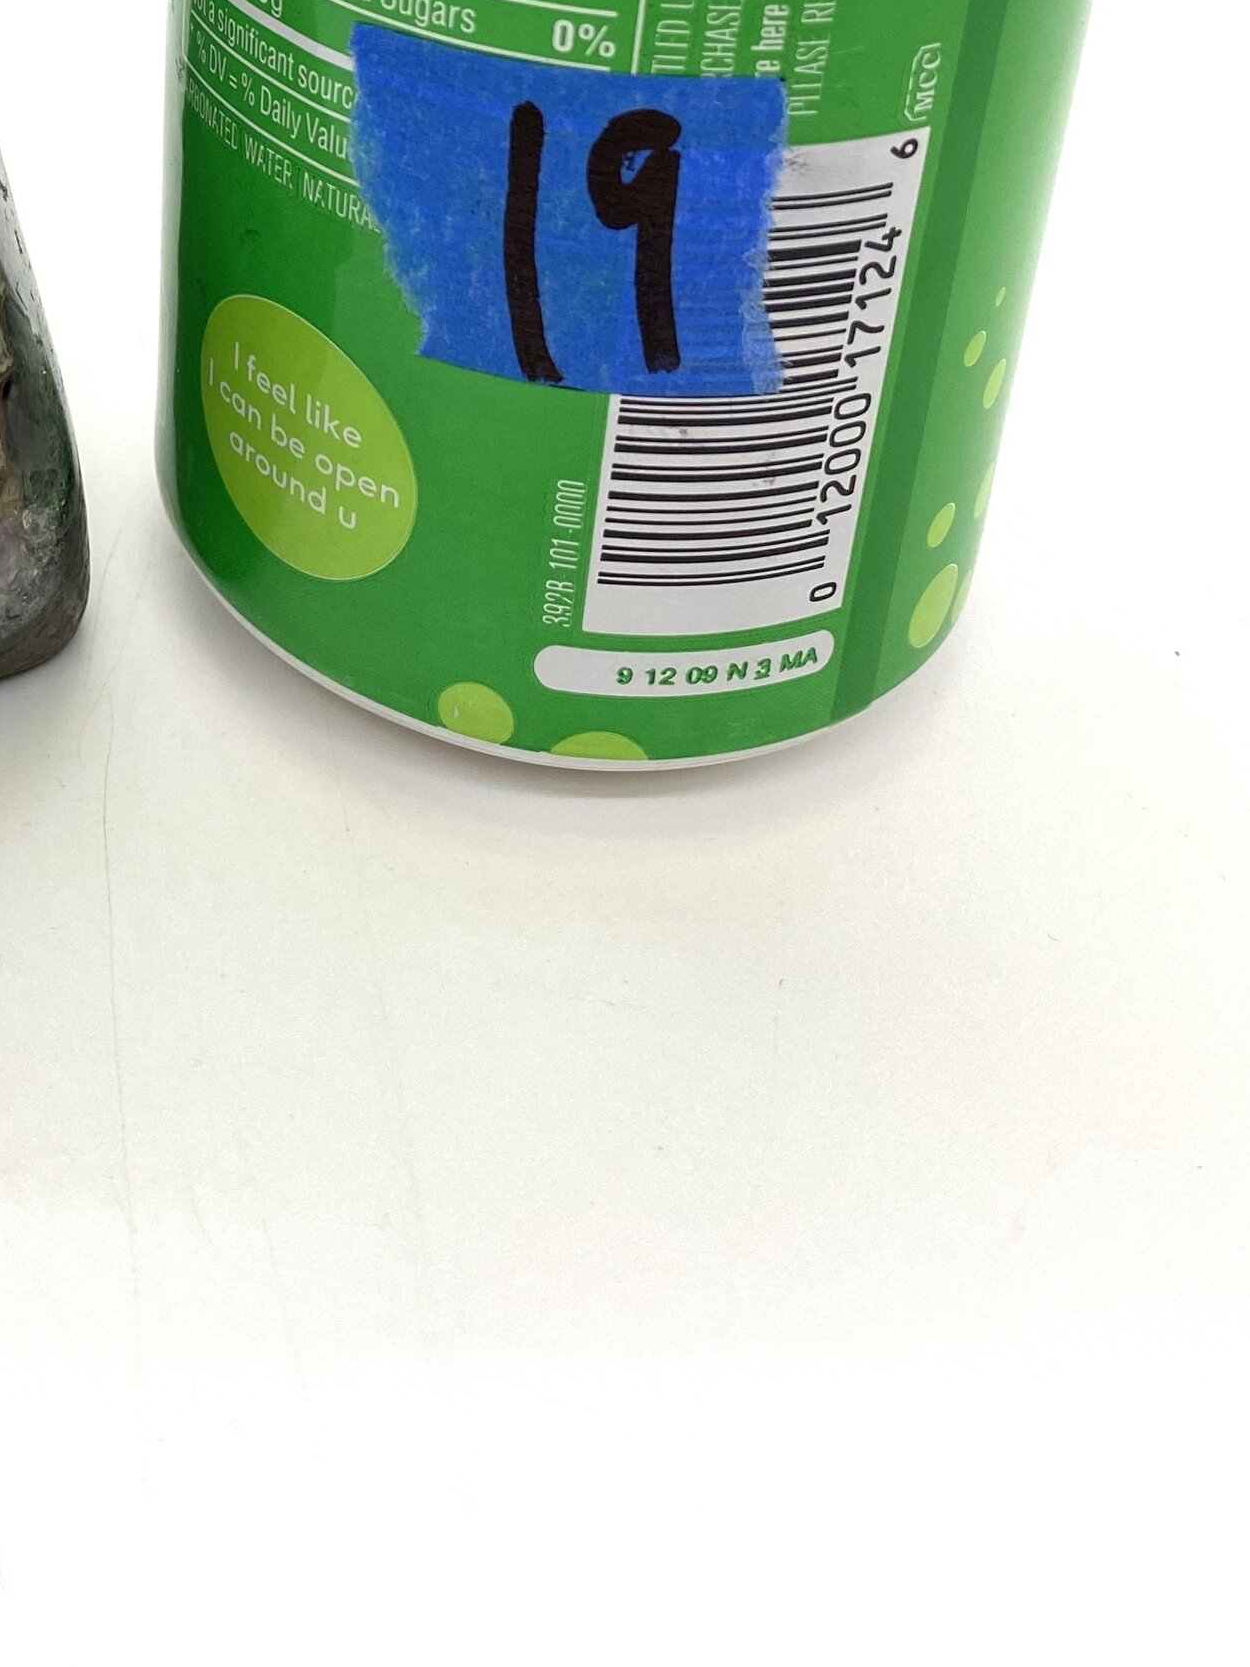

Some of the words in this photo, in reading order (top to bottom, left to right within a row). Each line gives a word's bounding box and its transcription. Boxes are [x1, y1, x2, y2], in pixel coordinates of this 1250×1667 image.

[208, 0, 216, 22] a
[217, 6, 295, 82] significant
[298, 64, 358, 110] sourc
[552, 18, 617, 59] 0%
[751, 3, 789, 52] here
[787, 33, 830, 116] PLEASE
[209, 43, 228, 82] DV
[260, 84, 301, 140] Daily
[306, 112, 353, 161] Valu
[913, 50, 942, 113] MCC
[185, 78, 239, 152] RBONATED
[303, 171, 382, 234] NATURA
[502, 99, 683, 383] 19
[234, 341, 240, 370] I
[246, 354, 296, 414] feel
[305, 394, 362, 448] like
[815, 391, 872, 525] 12000
[845, 226, 902, 368] 17124
[208, 357, 214, 386] I
[219, 381, 262, 430] can
[270, 413, 305, 459] be
[314, 453, 399, 508] open
[229, 431, 327, 515] around
[338, 505, 357, 530] u
[616, 667, 633, 684] 9
[645, 666, 676, 685] 12
[685, 665, 718, 685] 09
[726, 661, 748, 681] N
[779, 646, 818, 672] MA
